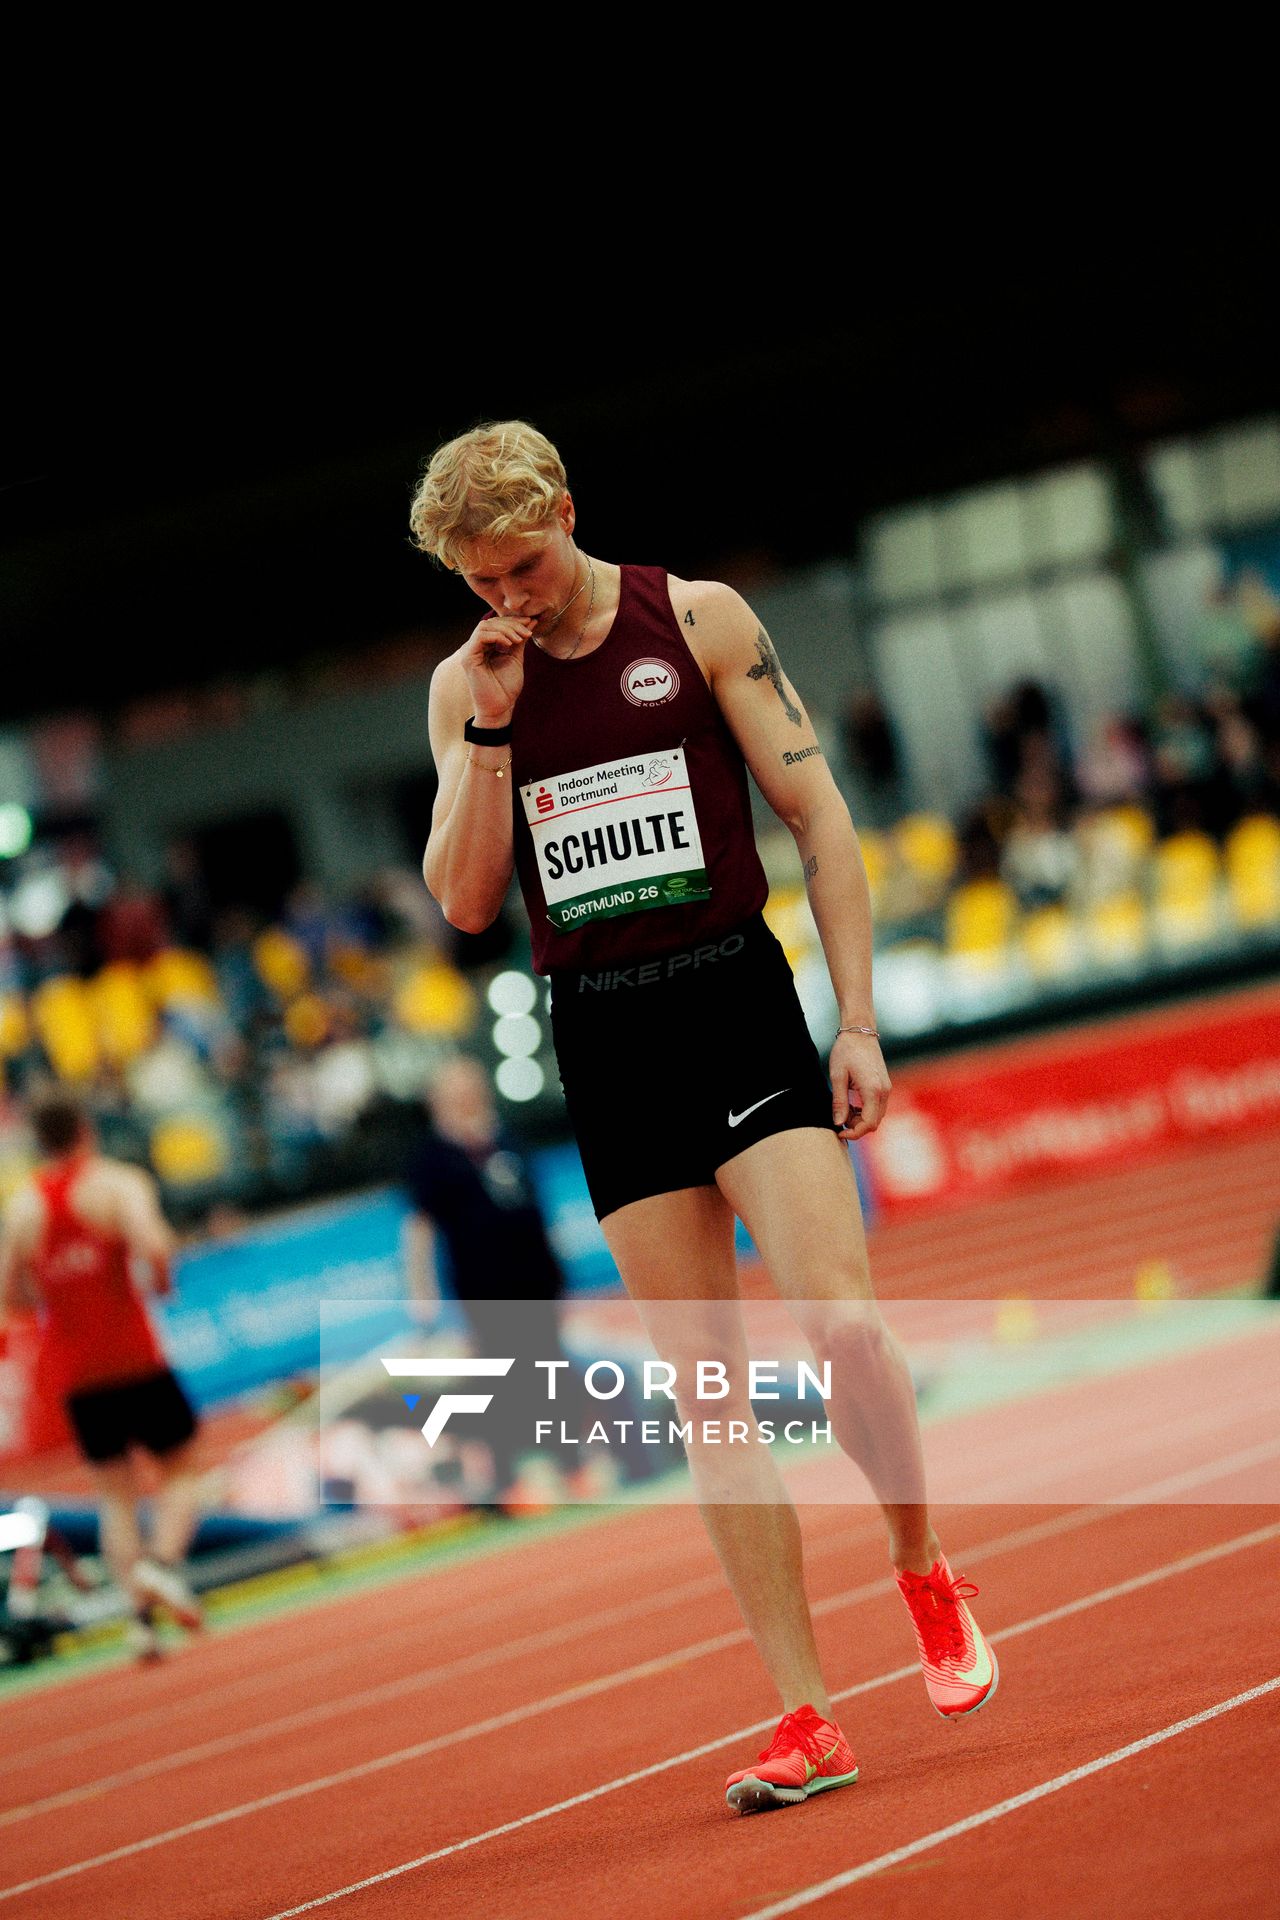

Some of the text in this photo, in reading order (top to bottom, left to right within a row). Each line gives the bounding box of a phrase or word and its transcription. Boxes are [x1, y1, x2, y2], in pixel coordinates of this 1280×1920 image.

[684, 609, 696, 626] 4
[632, 675, 668, 690] ASV
[558, 763, 645, 793] Indoor Meeting
[560, 782, 618, 807] Dortmund
[543, 810, 690, 881] SCHULTE
[561, 885, 659, 923] DORTMUND 26
[578, 933, 745, 993] NIKE PRO
